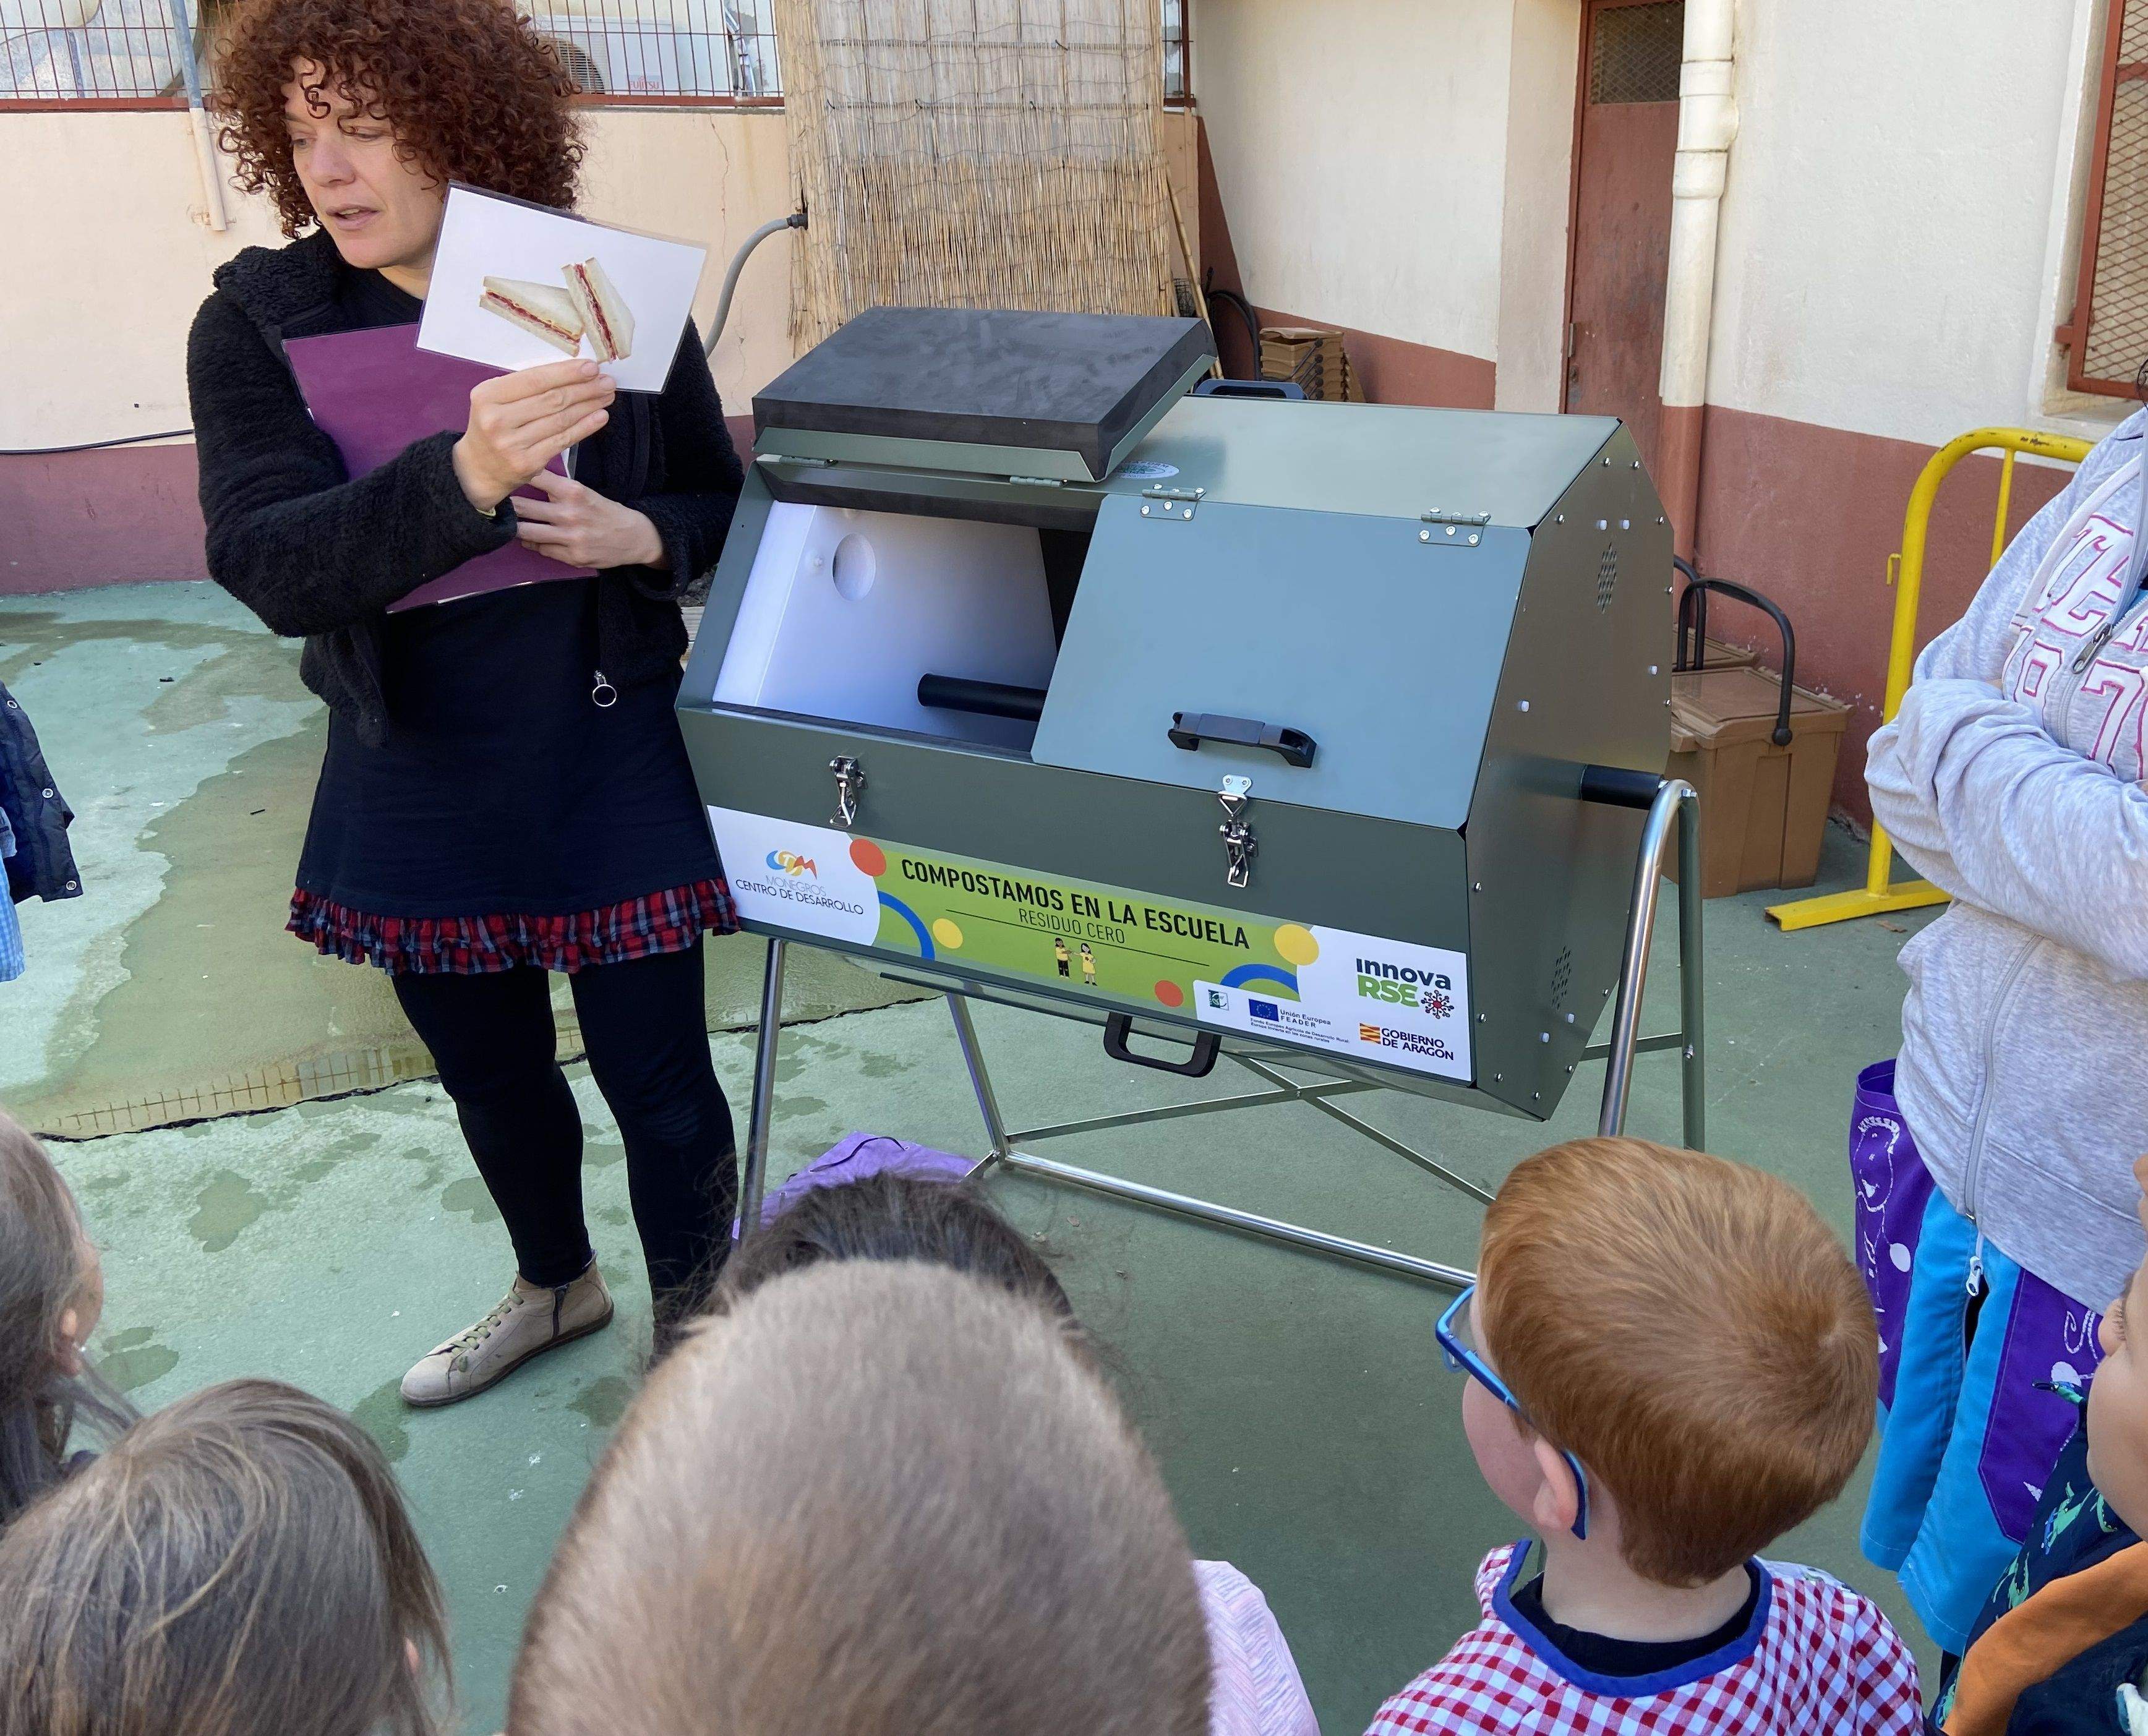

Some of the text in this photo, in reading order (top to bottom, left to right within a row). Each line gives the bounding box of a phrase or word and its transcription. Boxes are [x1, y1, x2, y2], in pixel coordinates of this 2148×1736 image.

[766, 874, 826, 896] MONEGROS
[735, 879, 864, 915] CENTRO DE DESARROLLO
[901, 858, 1250, 949] COMPOSTAMOS EN LA ESCUELA
[1019, 908, 1125, 944] RESIDUO CERO
[1357, 974, 1420, 1007] RSE
[1280, 1009, 1331, 1025] Unión Europea
[1280, 1015, 1316, 1028] FEADER
[1381, 1028, 1444, 1048] GOBIERNO
[1382, 1038, 1454, 1061] DE ARAGON
